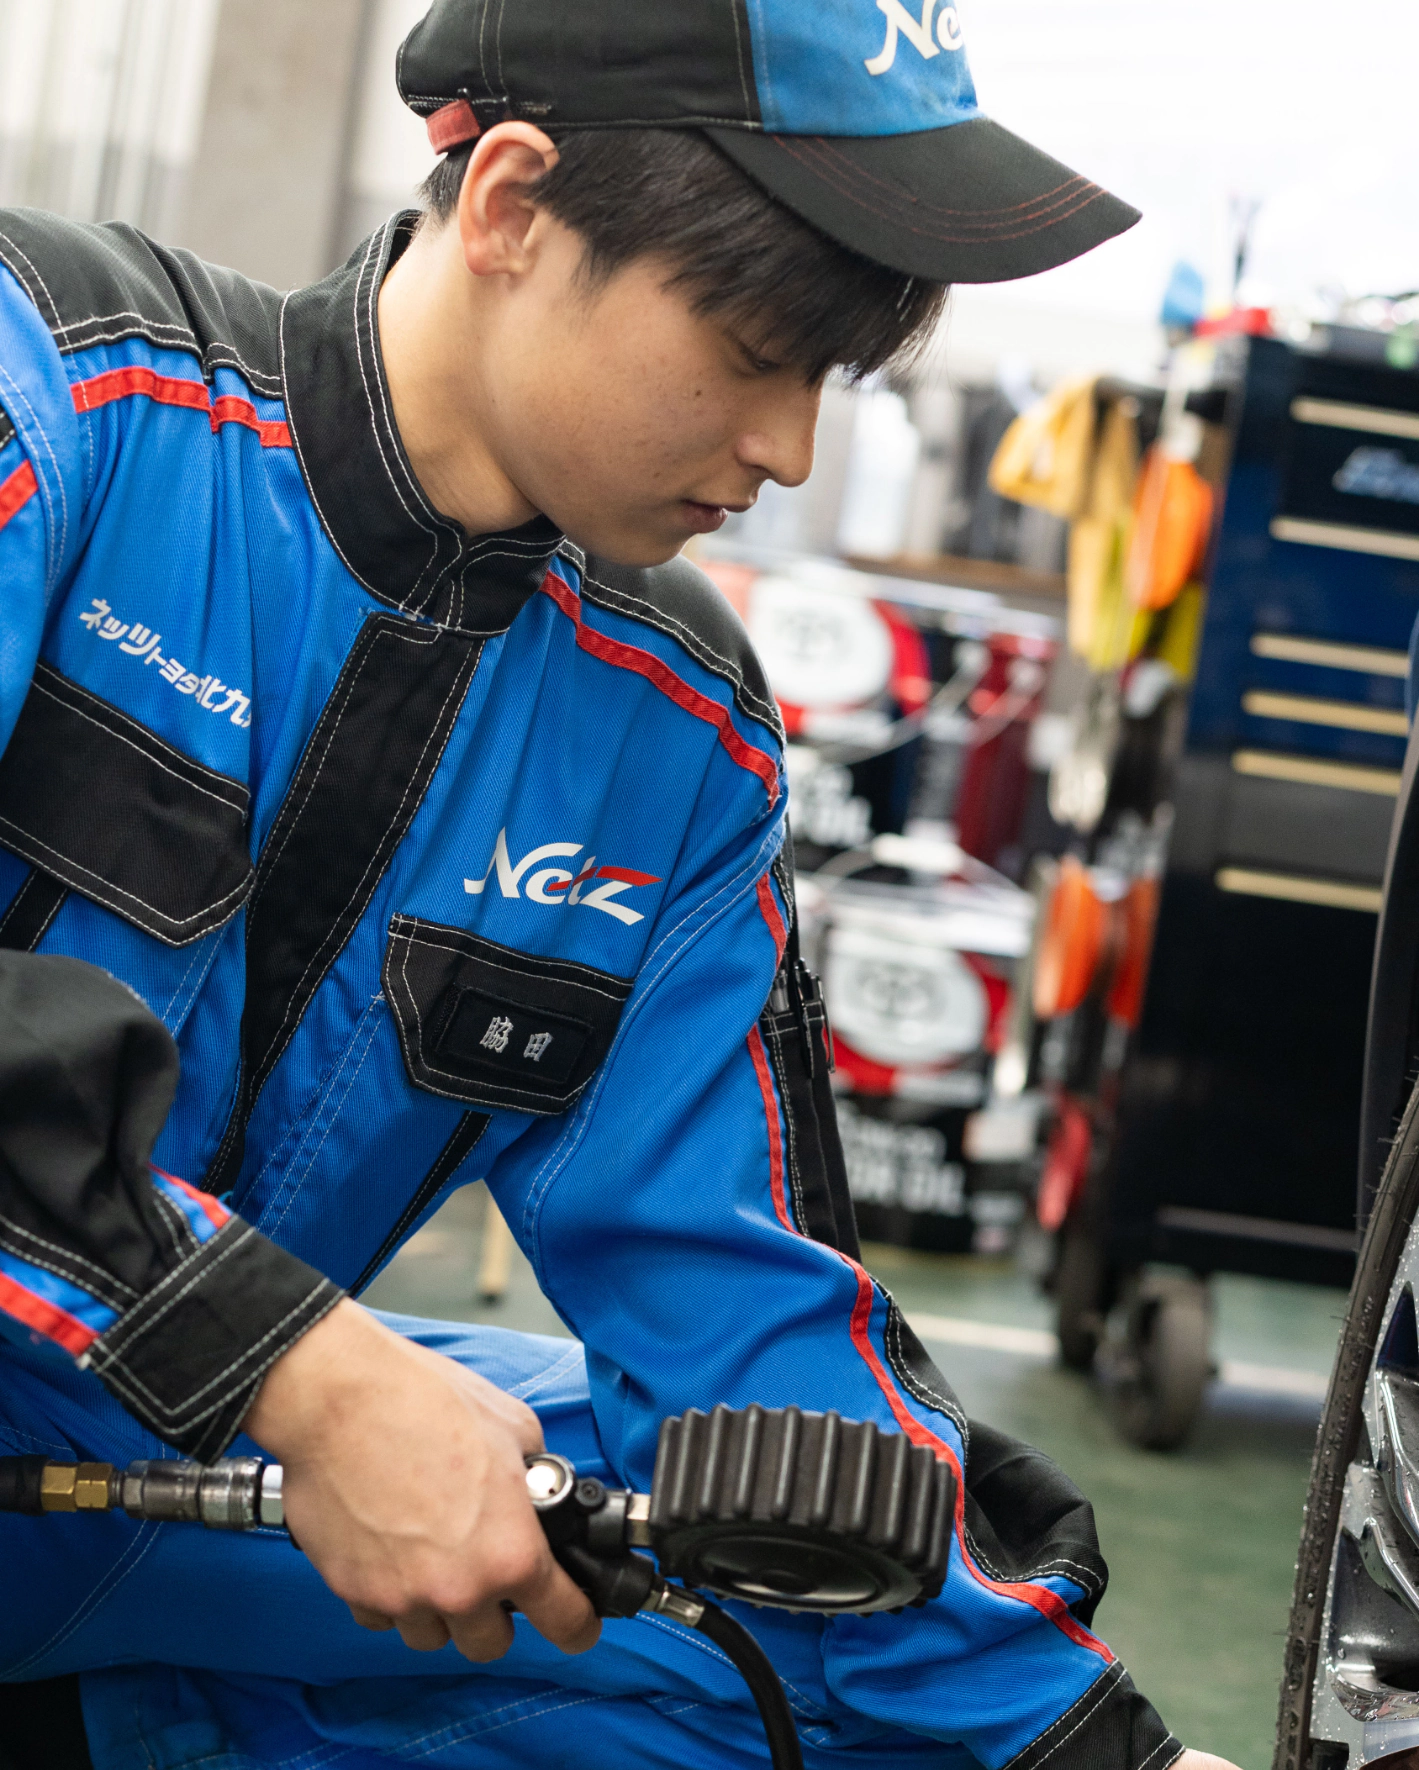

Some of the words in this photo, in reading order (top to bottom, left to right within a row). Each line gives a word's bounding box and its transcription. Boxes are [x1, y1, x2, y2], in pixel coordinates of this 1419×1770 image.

[79, 598, 252, 728] ネッツトヨタ北九
[463, 826, 663, 926] Netz
